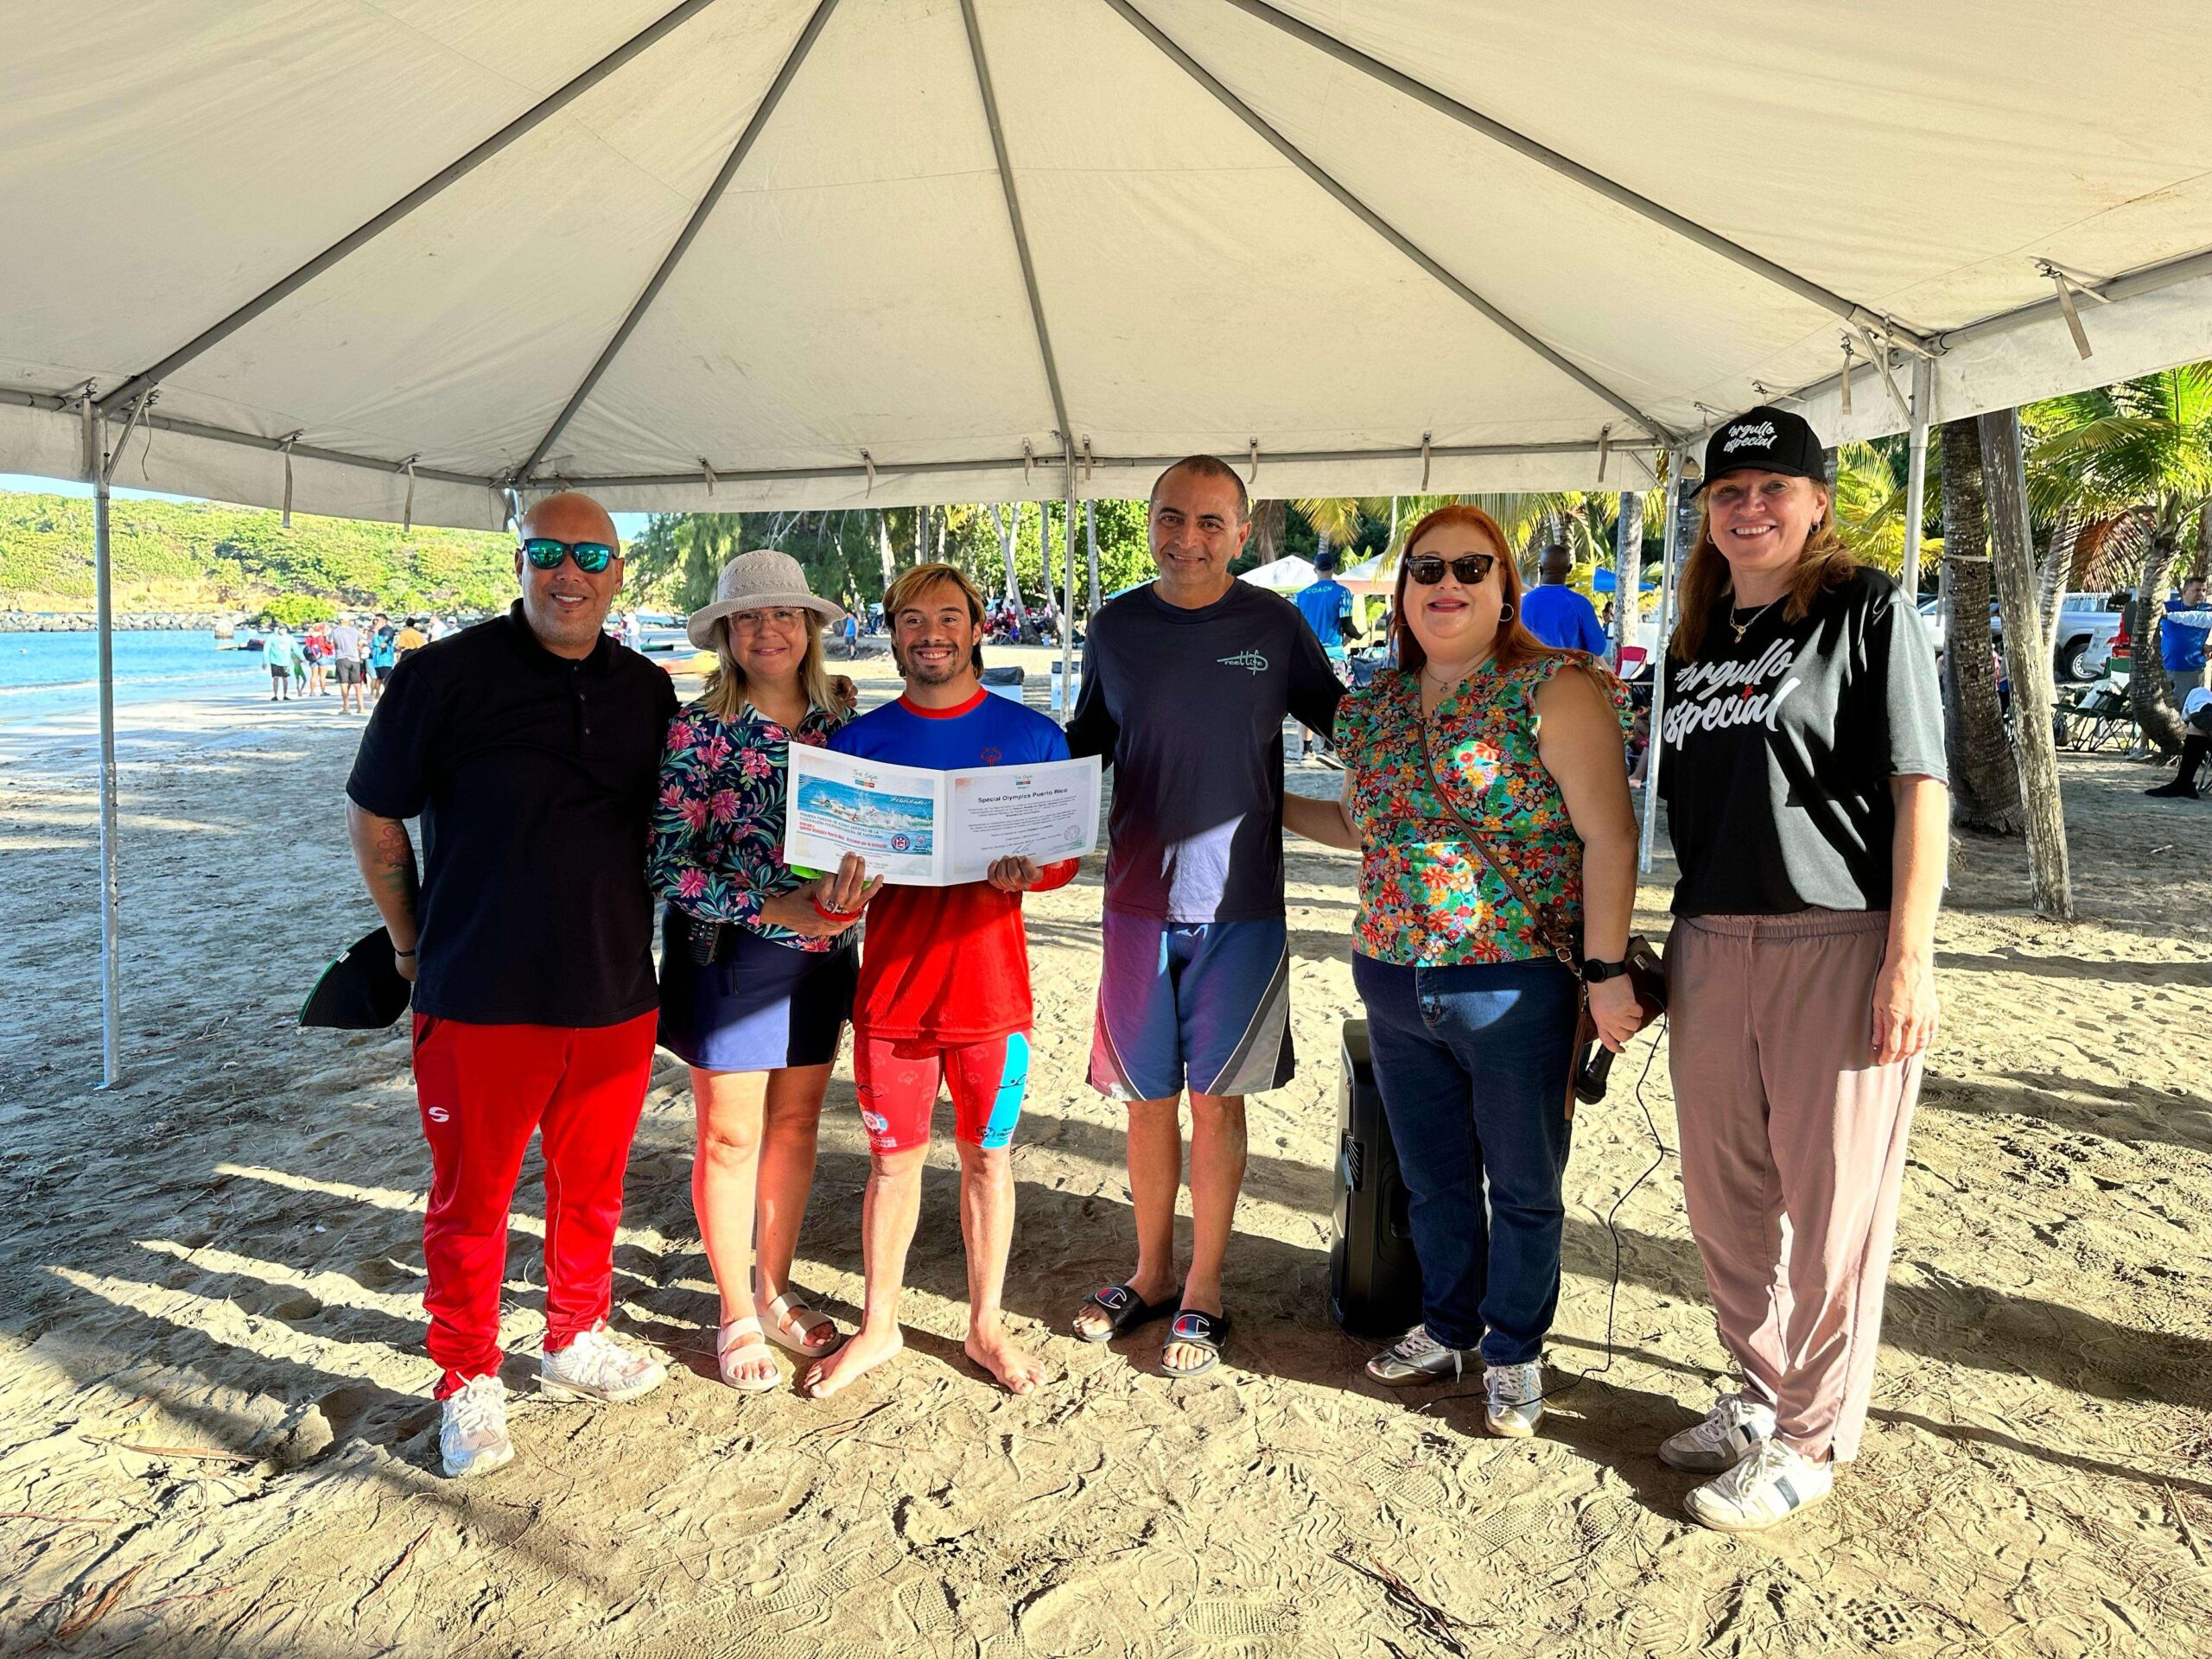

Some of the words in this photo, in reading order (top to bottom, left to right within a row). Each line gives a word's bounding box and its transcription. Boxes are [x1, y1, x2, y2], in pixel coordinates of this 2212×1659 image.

[1306, 585, 1333, 594] COACH
[977, 794, 1001, 804] Special
[1001, 793, 1031, 802] Olympics
